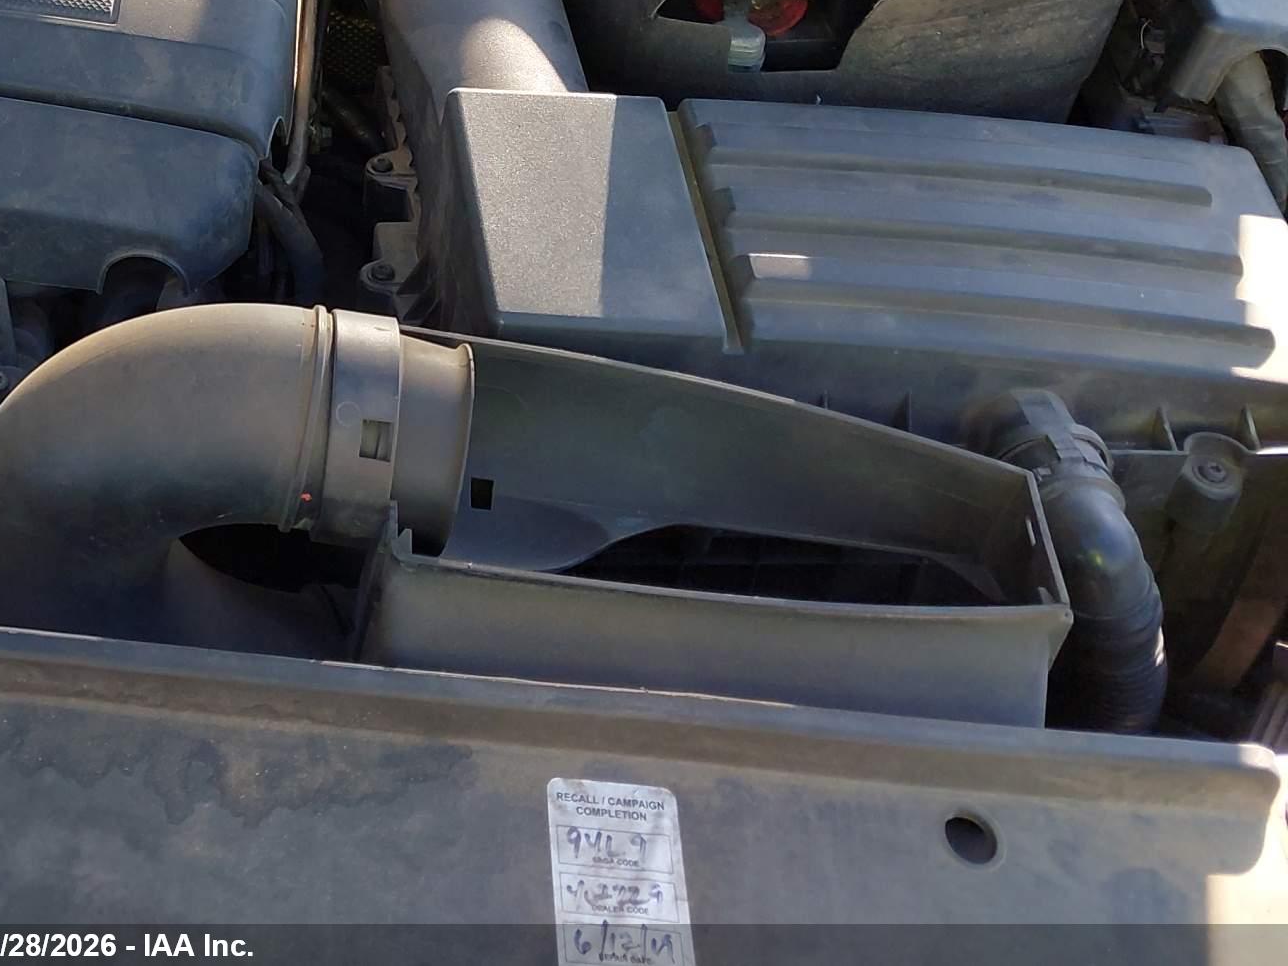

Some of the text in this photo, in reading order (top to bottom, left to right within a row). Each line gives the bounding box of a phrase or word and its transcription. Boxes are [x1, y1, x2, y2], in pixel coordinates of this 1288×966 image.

[556, 792, 599, 805] RECALL
[607, 797, 665, 811] CAMPAIGN
[576, 807, 647, 821] COMPLETION
